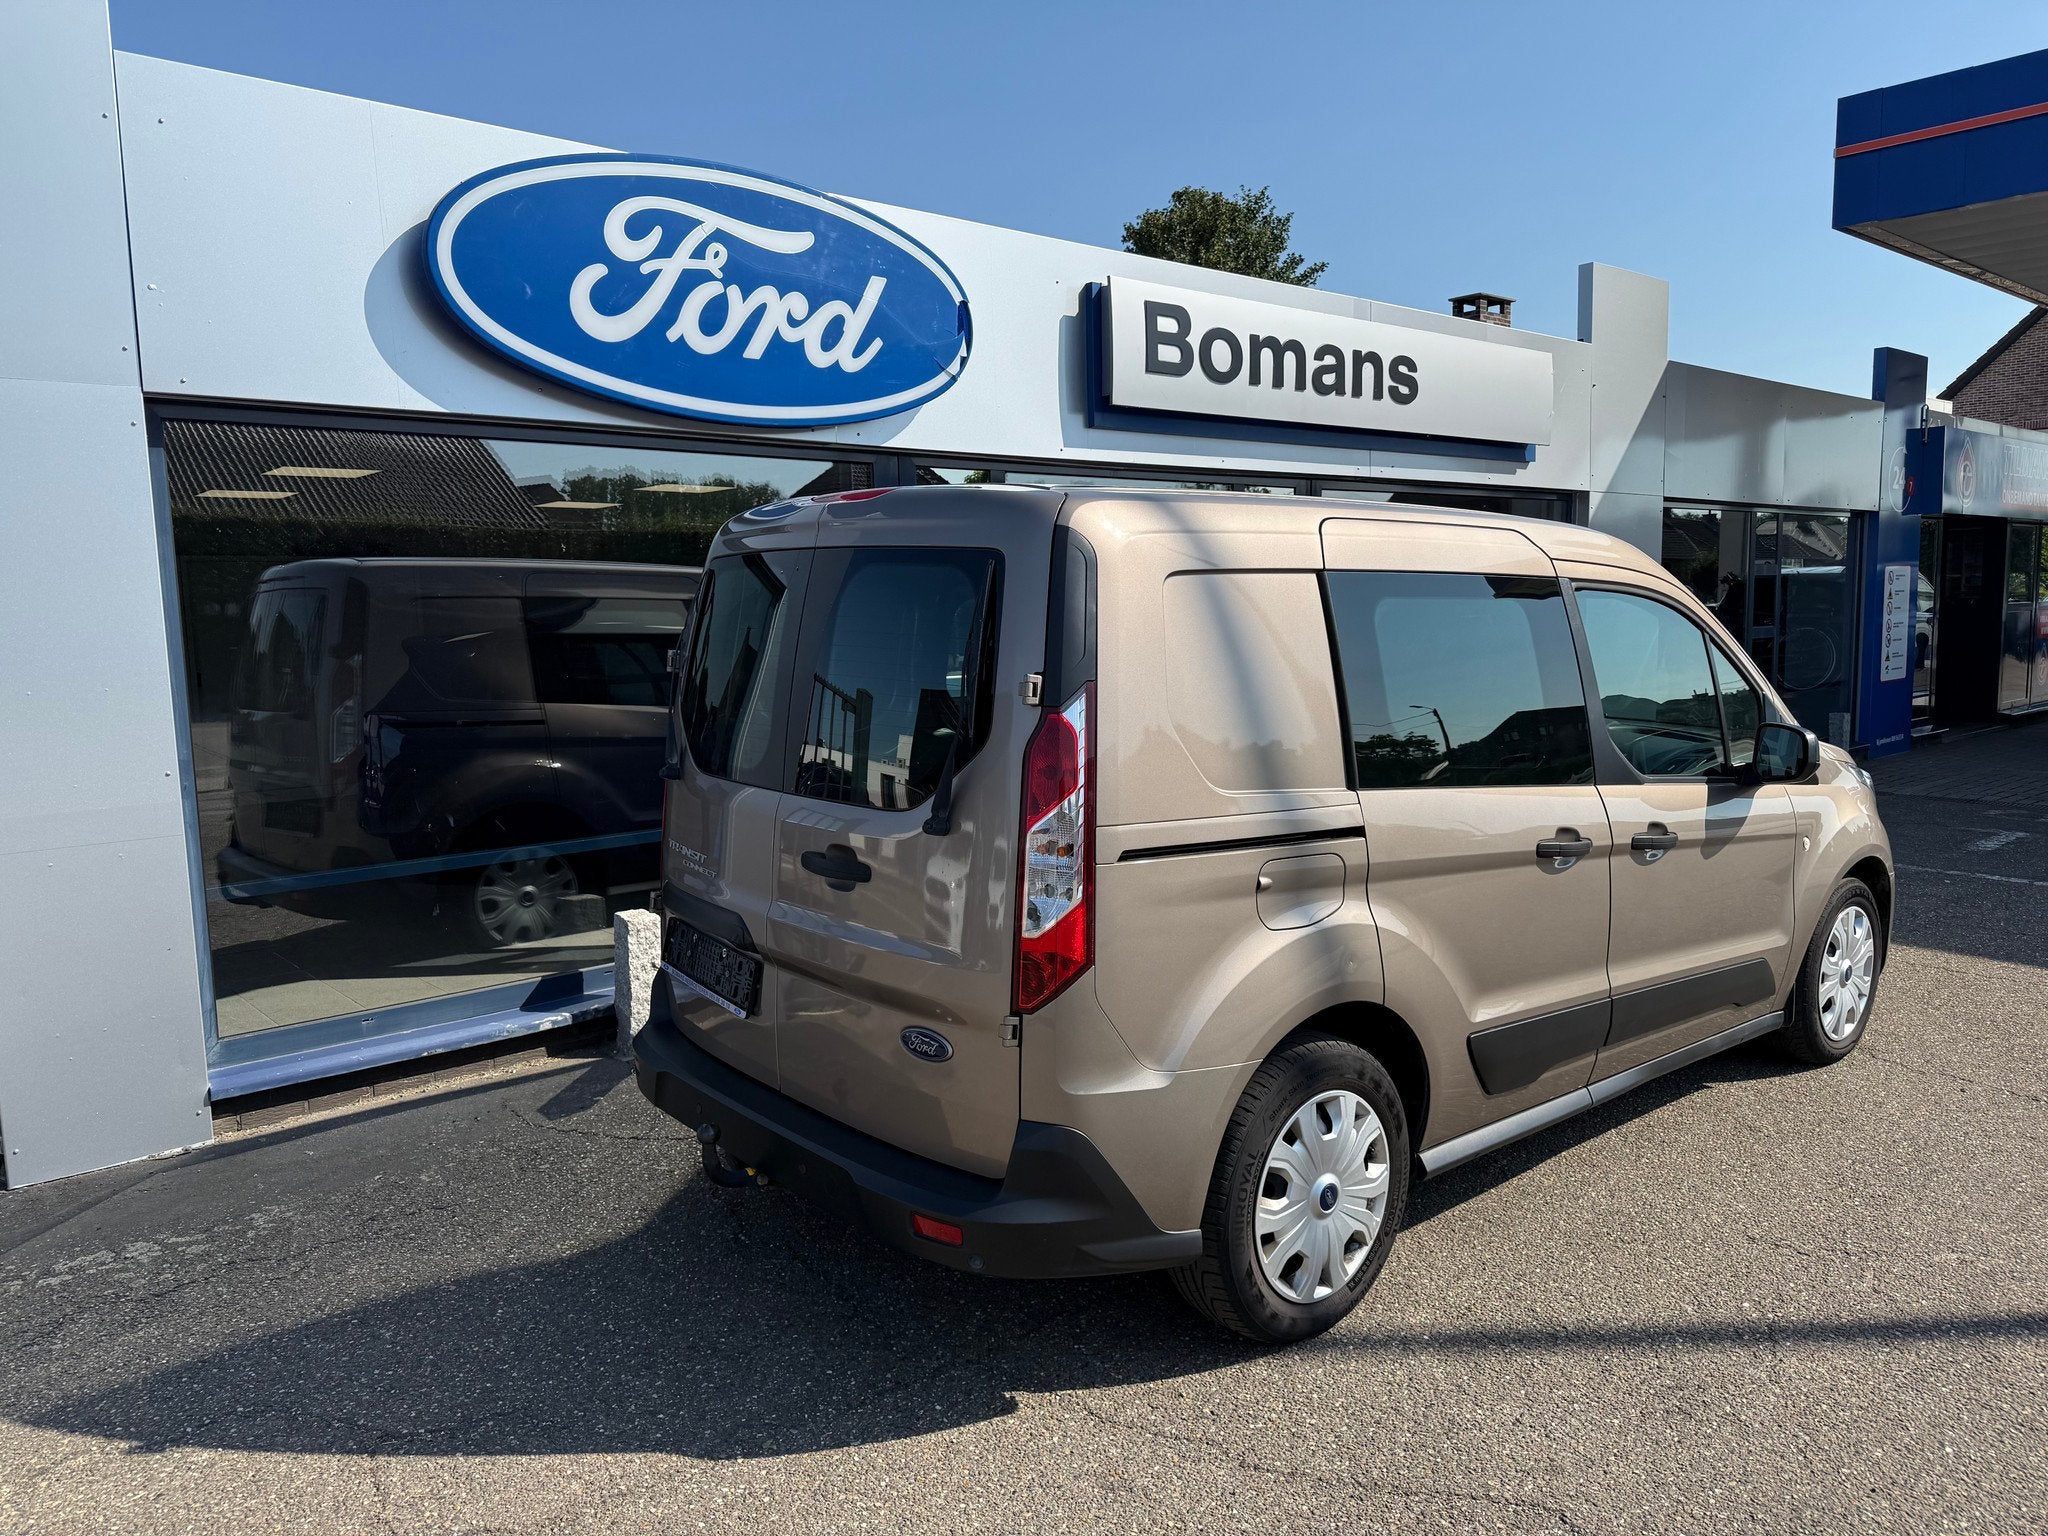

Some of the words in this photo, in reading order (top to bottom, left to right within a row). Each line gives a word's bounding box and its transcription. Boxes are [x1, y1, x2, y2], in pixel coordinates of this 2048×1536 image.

[570, 196, 886, 372] Ford
[1144, 300, 1419, 405] Bomans
[668, 838, 707, 863] TRANSIT
[682, 859, 717, 878] CONNECT
[909, 1033, 939, 1056] Ford
